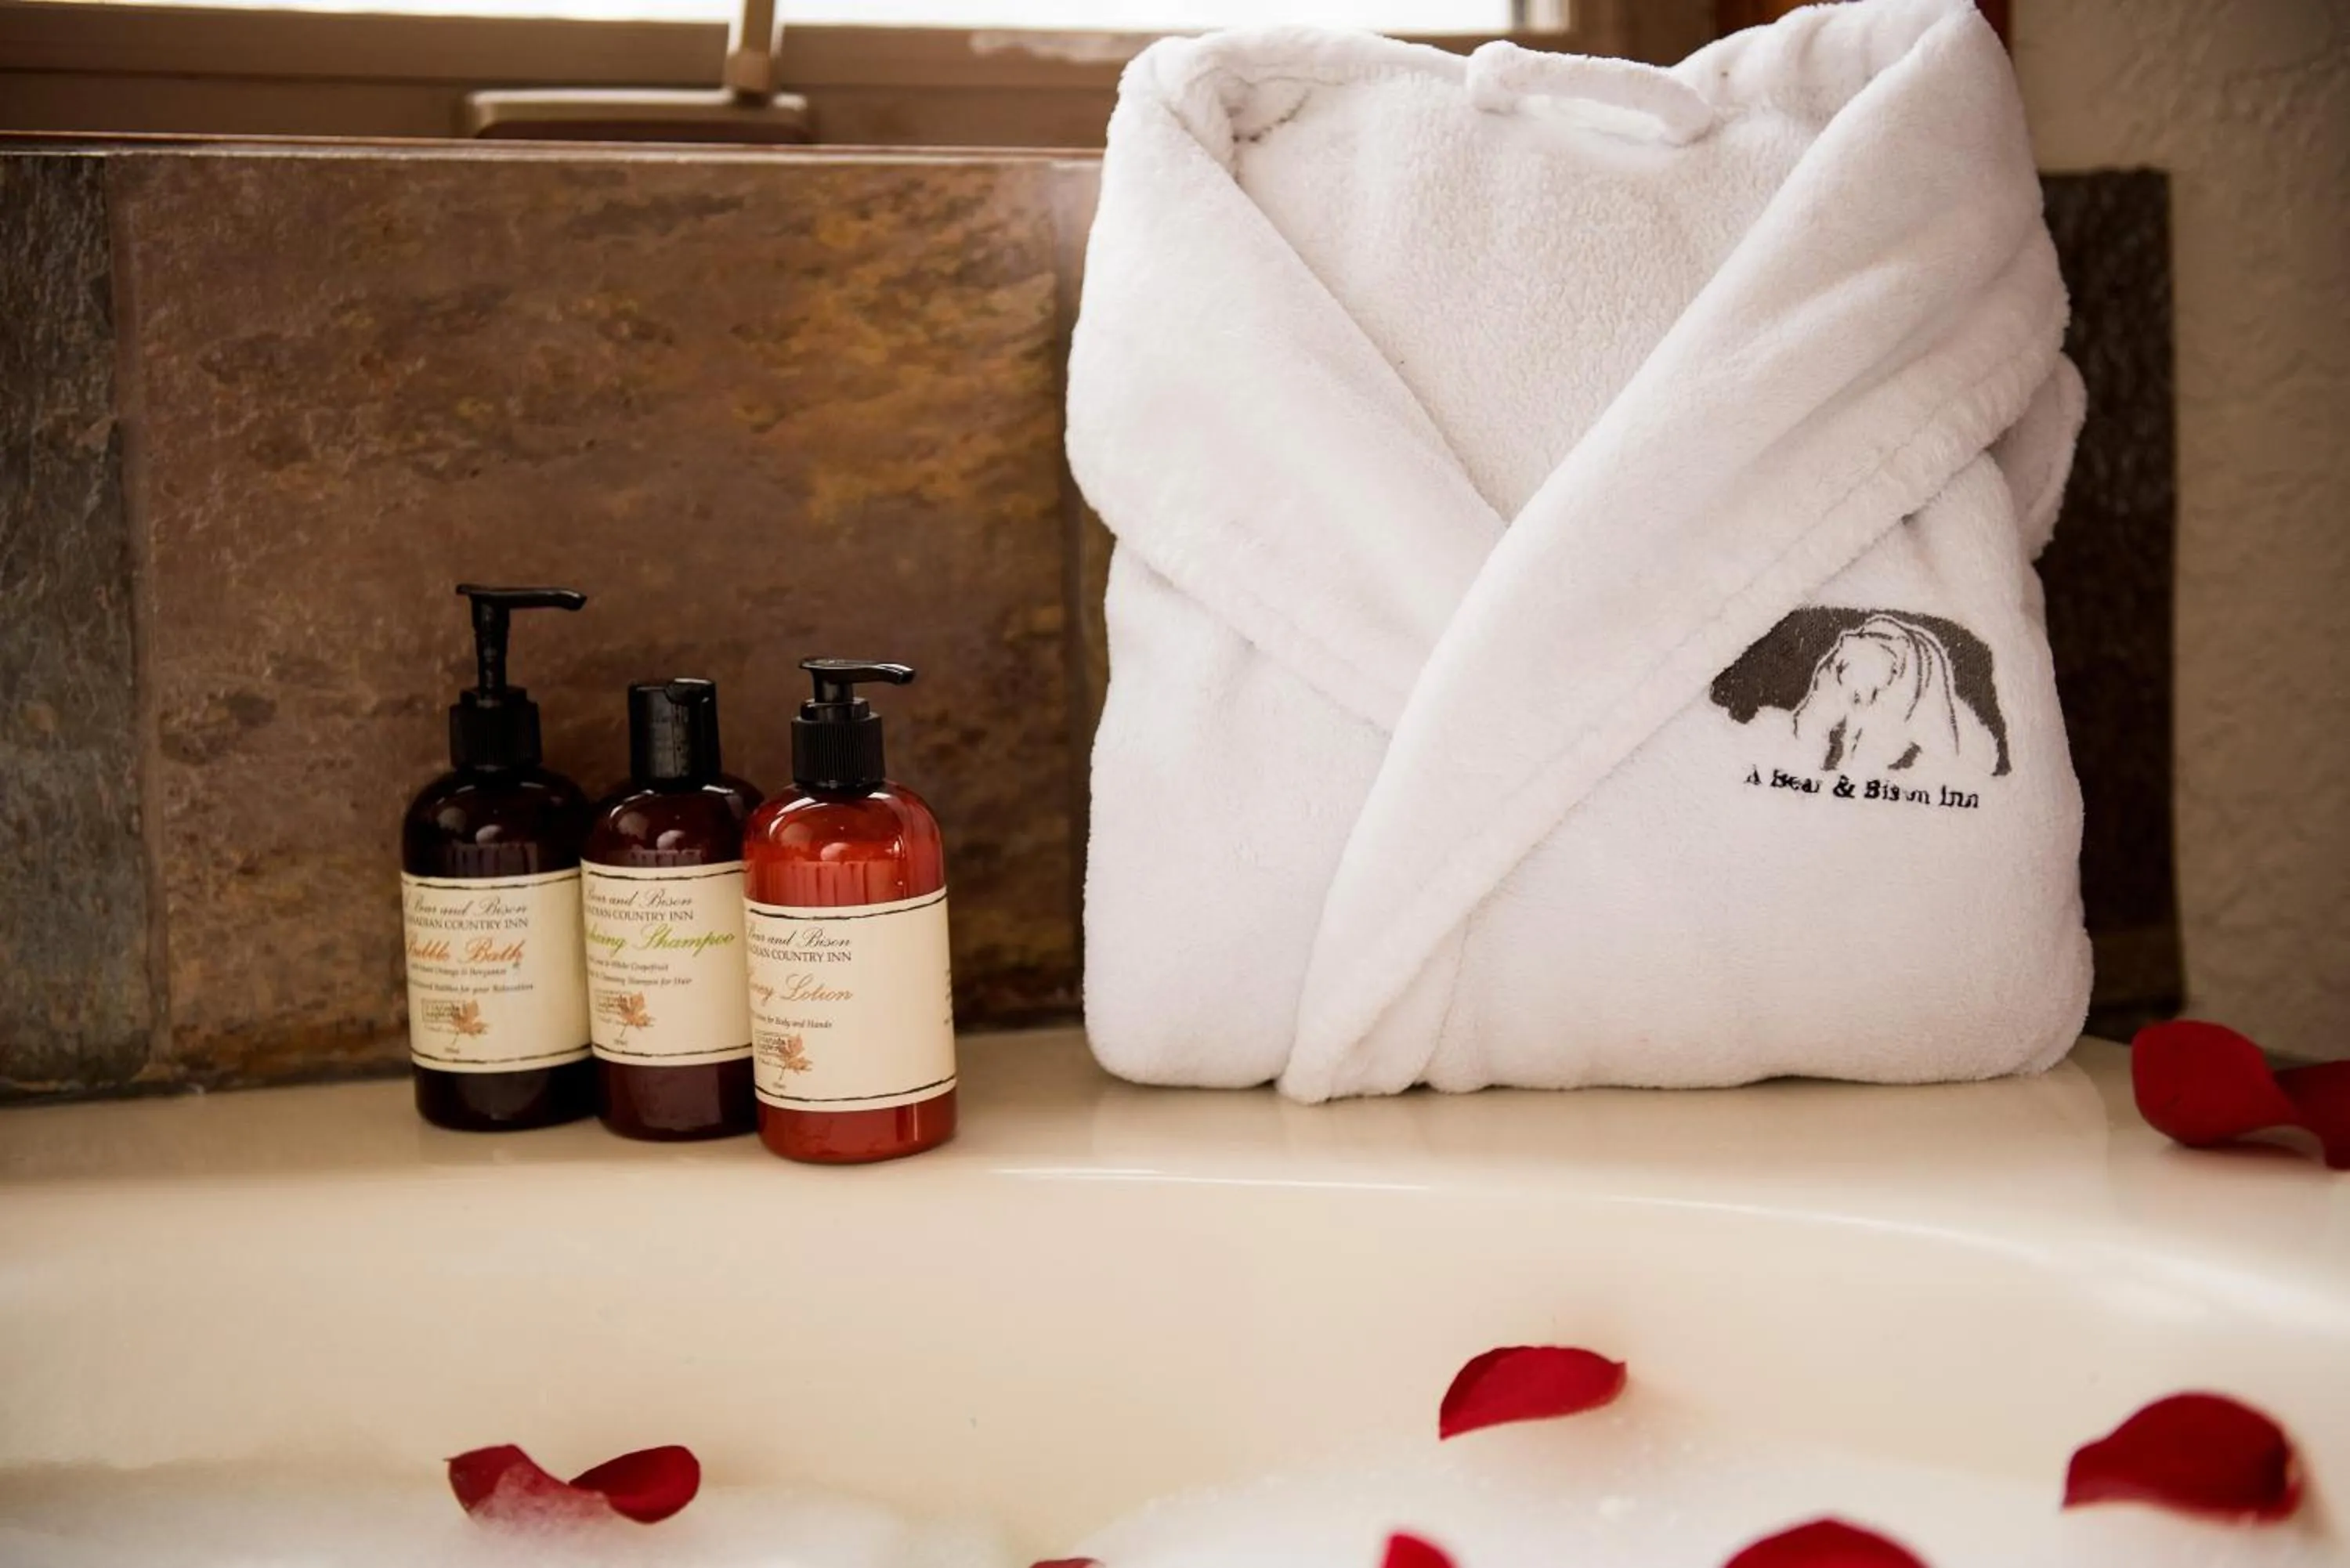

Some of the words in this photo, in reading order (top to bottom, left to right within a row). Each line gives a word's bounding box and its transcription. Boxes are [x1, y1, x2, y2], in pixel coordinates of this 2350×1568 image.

[1770, 769, 1820, 793] Bear
[1833, 775, 1855, 797] &
[1864, 780, 1930, 804] Bison
[1940, 786, 1979, 807] Inn
[475, 895, 528, 916] Bison
[609, 889, 638, 906] and
[639, 887, 693, 909] Bison
[444, 918, 501, 930] COUNTRY
[504, 918, 529, 929] INN
[613, 909, 667, 922] COUNTRY
[670, 910, 694, 921] INN
[630, 923, 736, 957] Shampoo
[767, 929, 797, 946] and
[796, 925, 851, 948] Bison
[457, 936, 527, 963] Bath
[772, 948, 825, 963] COUNTRY
[827, 951, 851, 963] INN
[780, 972, 853, 1003] Lotion
